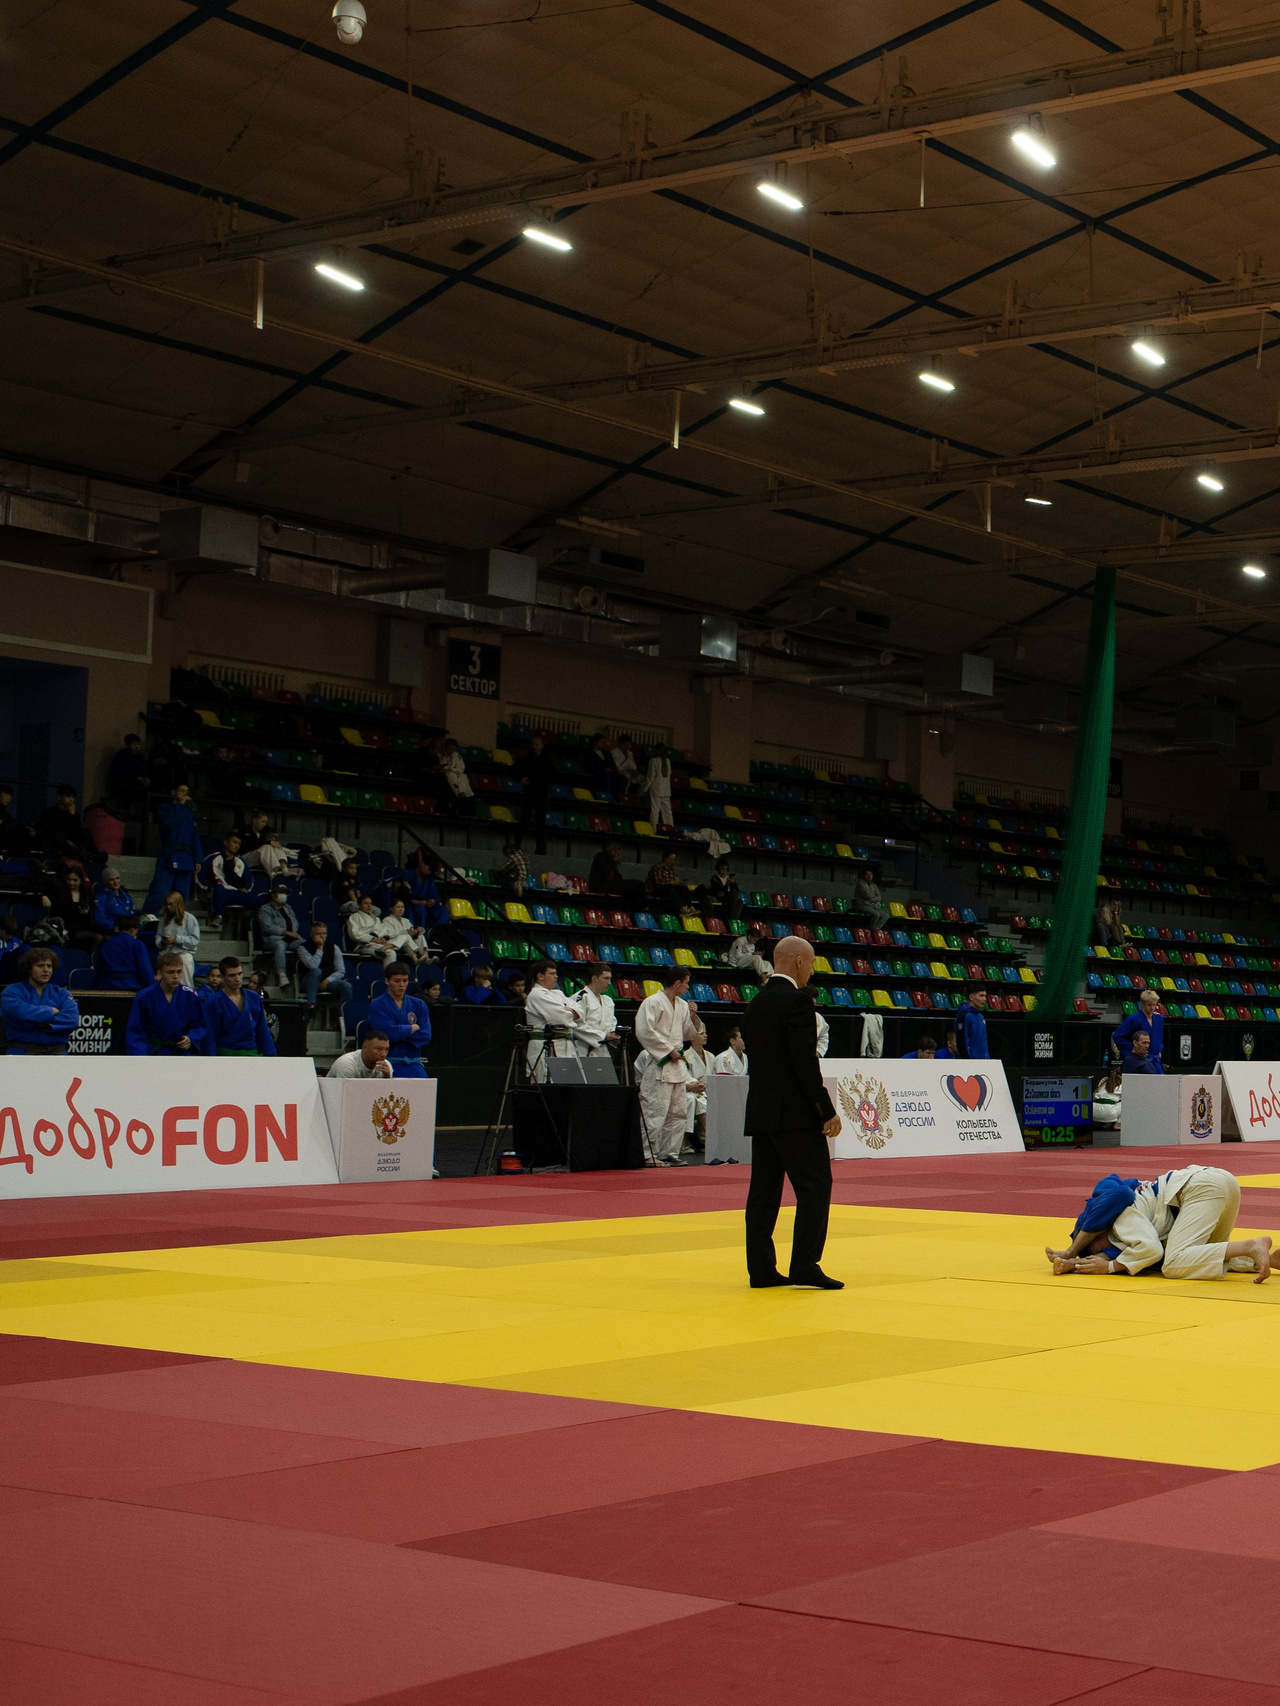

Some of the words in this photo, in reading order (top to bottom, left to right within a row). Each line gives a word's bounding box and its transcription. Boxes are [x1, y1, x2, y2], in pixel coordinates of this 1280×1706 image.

[468, 645, 481, 675] 3
[450, 674, 497, 695] СЕКТОР
[77, 1015, 105, 1027] ОРТ
[1034, 1033, 1050, 1041] СПОРТ
[67, 1041, 112, 1053] ЖИЗНИ
[1034, 1041, 1054, 1050] НОРМА
[1034, 1050, 1054, 1059] ЖИЗНИ
[1072, 1086, 1079, 1099] 1
[895, 1102, 931, 1112] ДЗЮДО
[1072, 1104, 1080, 1117] 0
[898, 1117, 935, 1127] РОССИИ
[956, 1119, 997, 1129] КОЛЫБЕЛЬ
[958, 1131, 1002, 1141] ОТЕЧЕСТВА
[1042, 1126, 1075, 1143] 0:25
